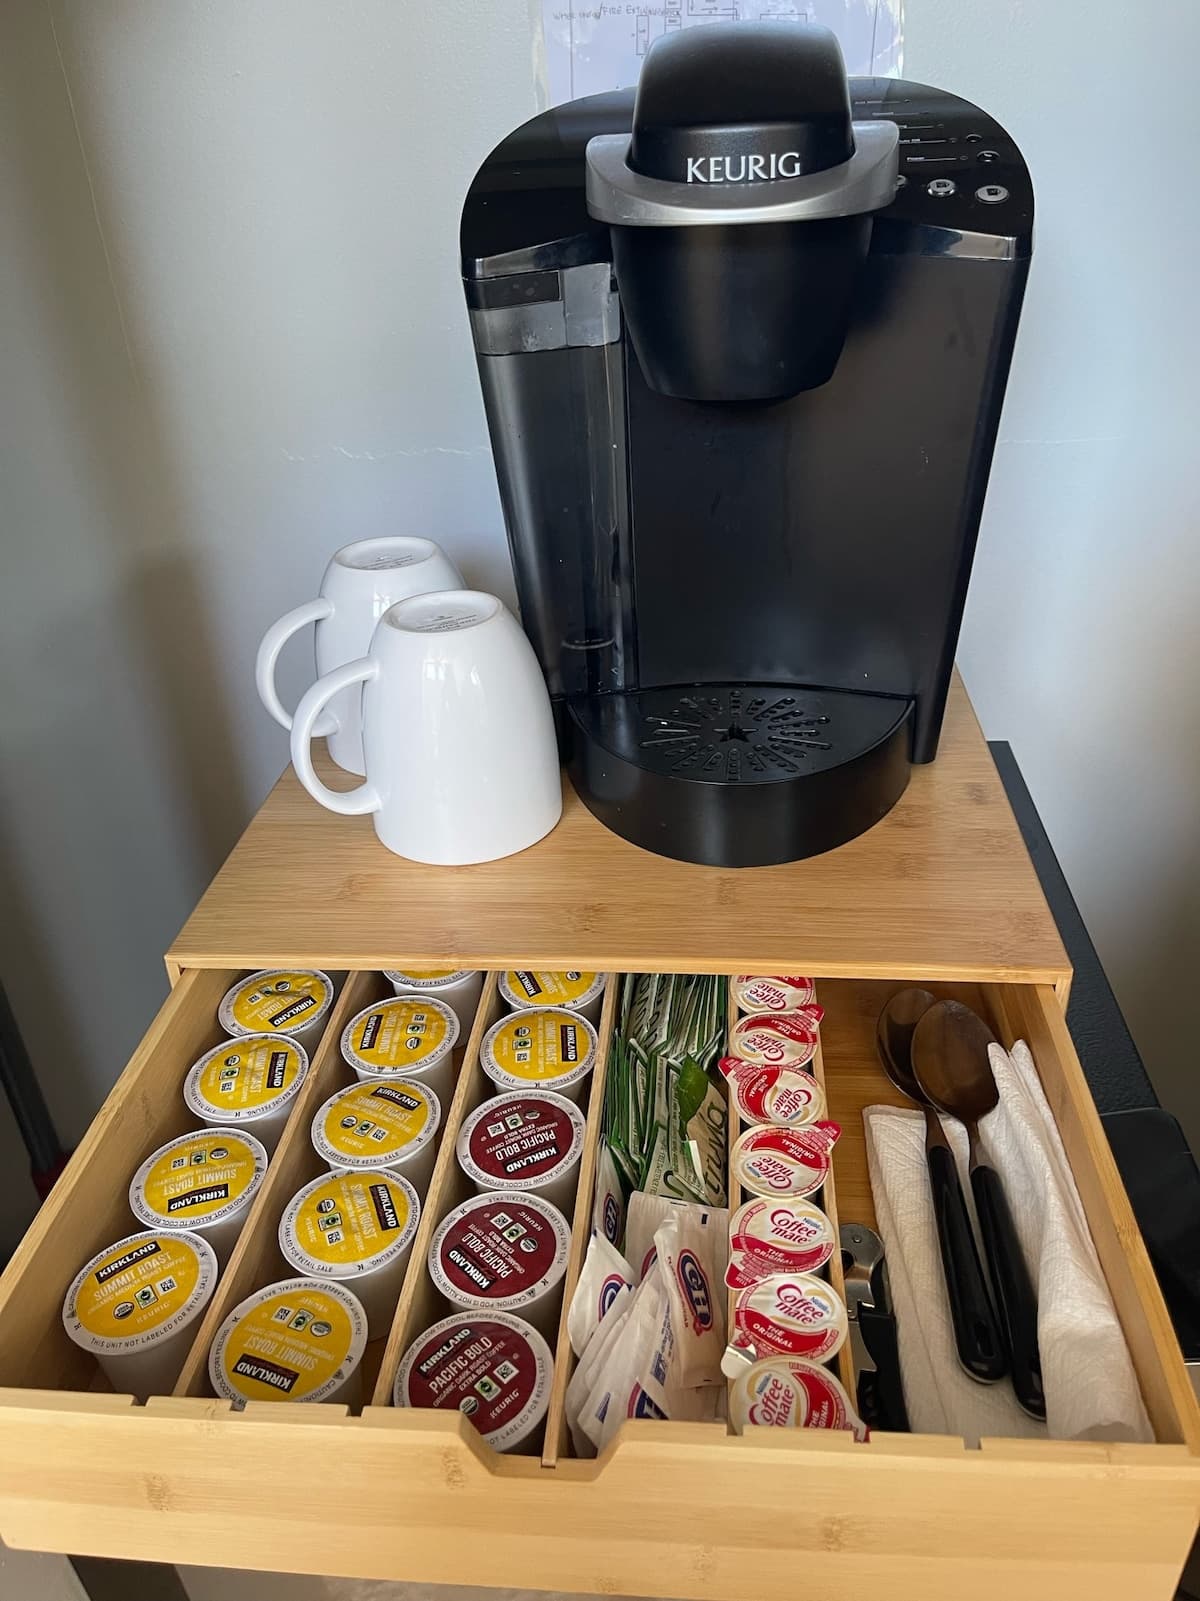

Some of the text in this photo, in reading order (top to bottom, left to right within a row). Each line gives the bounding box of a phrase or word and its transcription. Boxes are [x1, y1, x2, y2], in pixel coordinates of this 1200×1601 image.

[687, 152, 800, 182] KEURIG
[749, 988, 786, 1011] Coffee
[757, 982, 786, 1000] mate
[274, 999, 314, 1026] KIRKLAND
[567, 1026, 576, 1060] KIRKLAND
[747, 1037, 784, 1061] Coffee
[755, 1033, 786, 1048] mate
[376, 1087, 418, 1108] KIRKLAND
[773, 1088, 793, 1112] mate
[780, 1089, 813, 1118] Coffee
[495, 1129, 556, 1161] PACIFIC BOLD
[782, 1139, 816, 1159] ORIGINAL
[787, 1148, 804, 1159] THE
[506, 1146, 557, 1173] KIRKLAND
[763, 1157, 795, 1177] mate
[197, 1169, 237, 1184] SUMMIT
[752, 1161, 792, 1189] Coffee
[170, 1189, 226, 1210] KIRKLAND
[378, 1186, 397, 1227] KIRKLAND
[770, 1209, 817, 1237] Coffee
[771, 1227, 808, 1244] mate
[99, 1243, 157, 1278] KIRKLAND
[462, 1233, 513, 1278] PACIFIC BOLD
[754, 1248, 794, 1265] ORIGINAL
[767, 1248, 785, 1258] THE
[94, 1252, 172, 1301] SUMMIT ROAST
[316, 1263, 333, 1272] SALE
[449, 1250, 490, 1288] KIRKLAND
[90, 1275, 208, 1348] THIS UNIT NOT LABELED FOR RETAIL SALE
[775, 1302, 812, 1324] mate
[776, 1283, 824, 1319] Coffee
[446, 1316, 464, 1326] COOL
[767, 1325, 785, 1336] THE
[753, 1323, 793, 1348] ORIGINAL
[243, 1335, 319, 1370] SUMMIT ROAST
[420, 1328, 471, 1373] KIRKLAND
[236, 1362, 292, 1389] KIRKLAND
[429, 1336, 493, 1394] PACIFIC BOLD
[433, 1340, 507, 1408] ORGANIC DARK ROAST COFFEE
[459, 1361, 492, 1392] EXTRA BOLD
[489, 1390, 520, 1419] KEURIG
[749, 1379, 783, 1426] Coffee
[775, 1387, 795, 1427] mate
[501, 1414, 529, 1439] LABELED
[528, 1400, 539, 1413] FOR
[809, 1410, 820, 1428] THE
